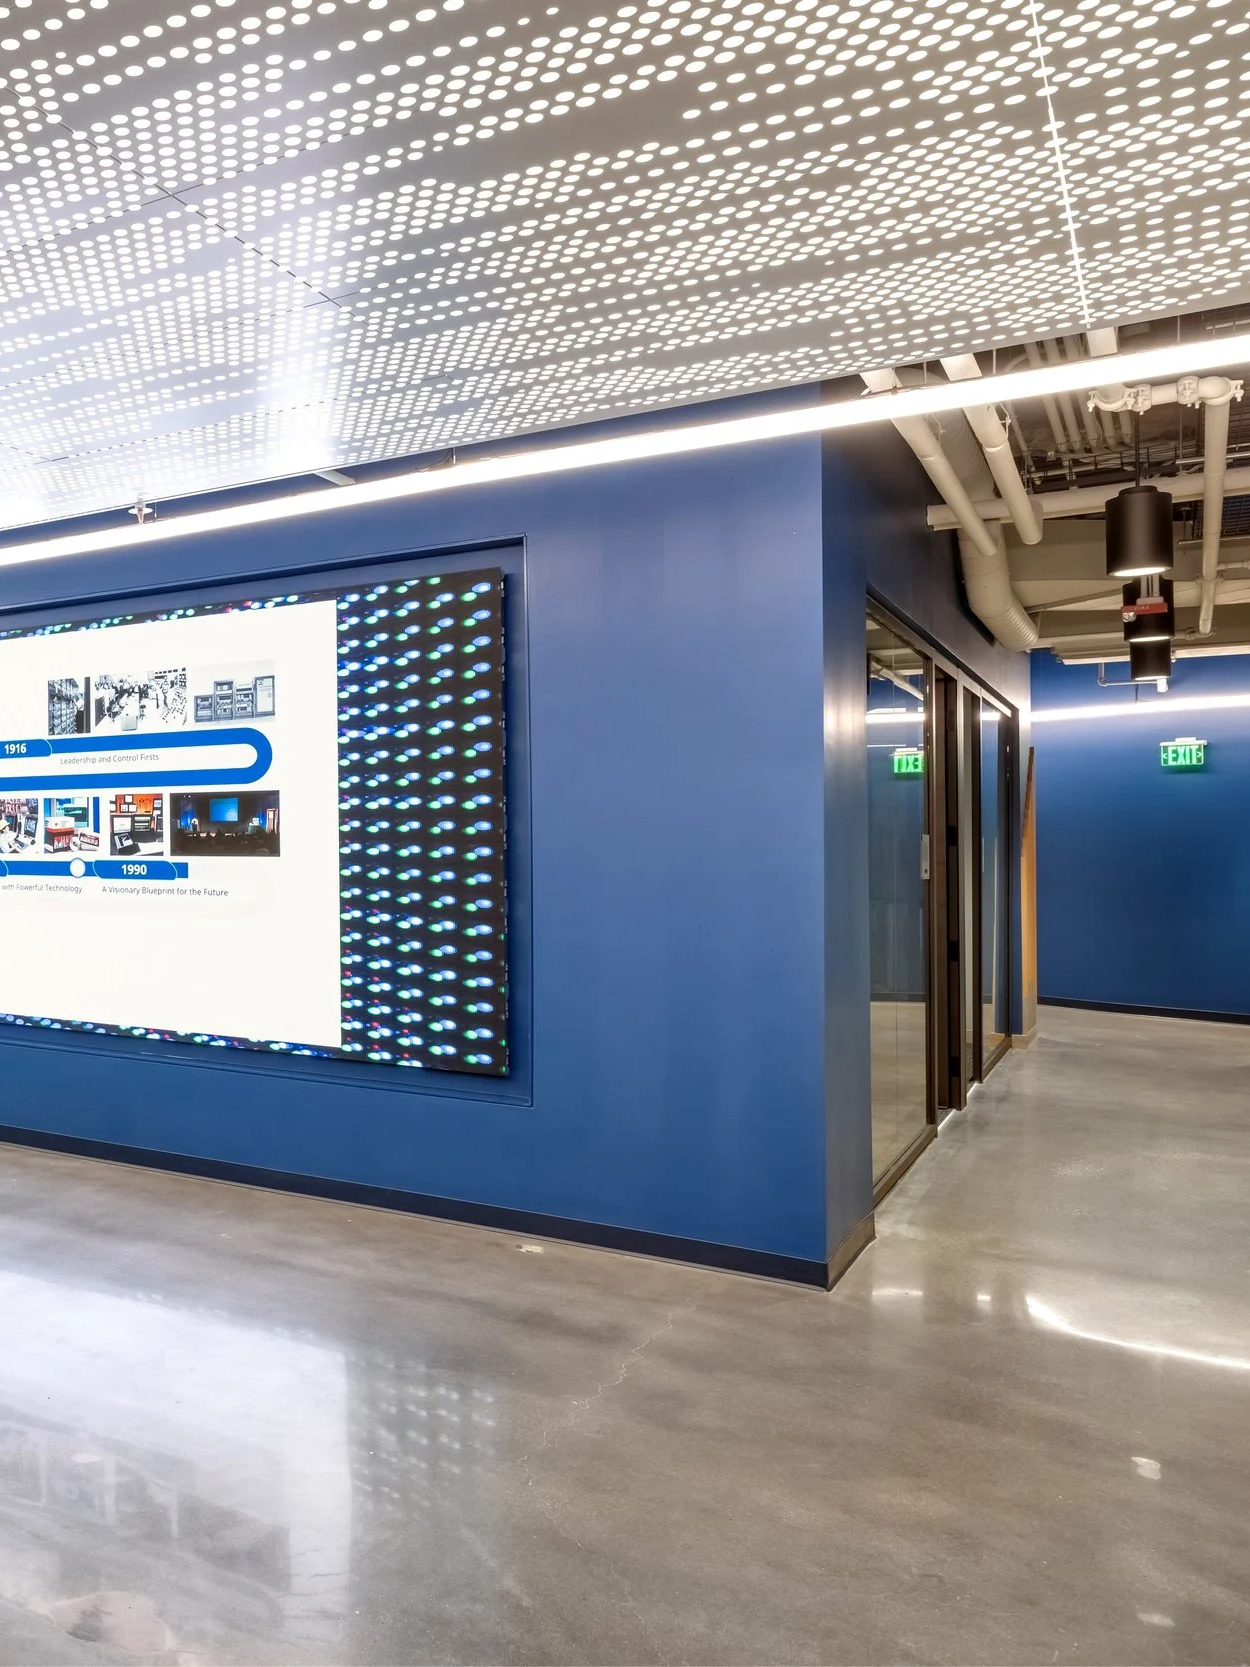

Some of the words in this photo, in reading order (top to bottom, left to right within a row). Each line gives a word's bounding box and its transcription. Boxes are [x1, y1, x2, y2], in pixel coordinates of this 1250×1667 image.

[4, 743, 27, 754] 1916
[60, 757, 97, 765] Leadership
[112, 754, 139, 763] Control
[140, 753, 160, 761] Firsts
[1168, 745, 1198, 765] EXIT
[121, 864, 147, 875] 1990
[1, 883, 15, 891] with
[45, 884, 83, 895] Technology
[108, 886, 140, 896] Visionary
[141, 887, 175, 896] Blueprint
[176, 887, 188, 896] for
[189, 888, 202, 896] the
[203, 888, 229, 897] Future
